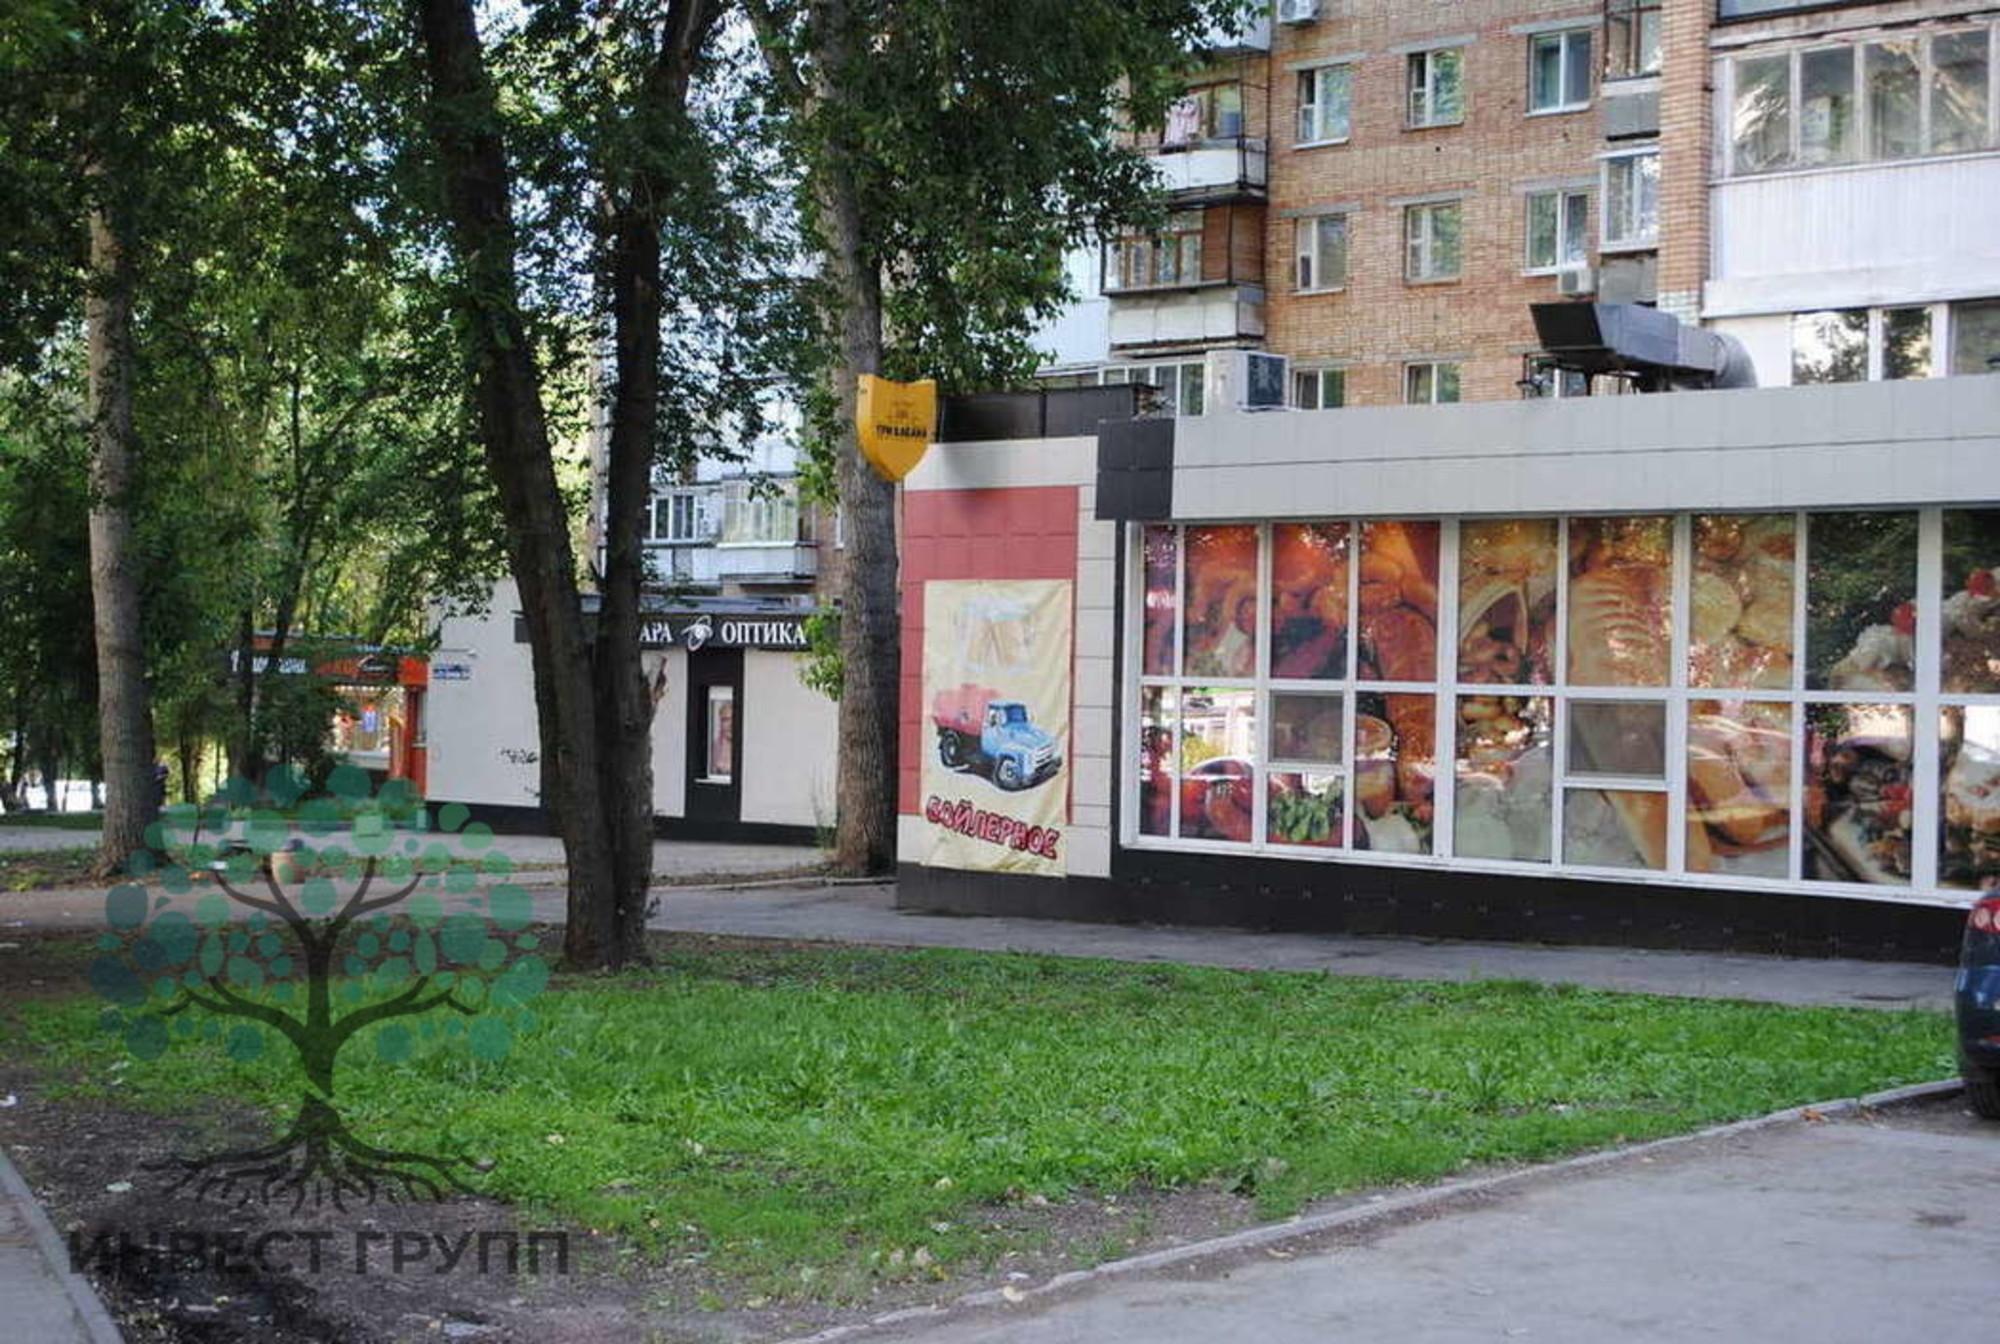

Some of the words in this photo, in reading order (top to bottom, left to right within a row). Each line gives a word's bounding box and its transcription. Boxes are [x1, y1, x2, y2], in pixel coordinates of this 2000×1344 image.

[639, 621, 673, 643] АРА
[721, 621, 808, 645] ОПТИКА
[926, 795, 1060, 860] БОЙЛЕРНОЕ
